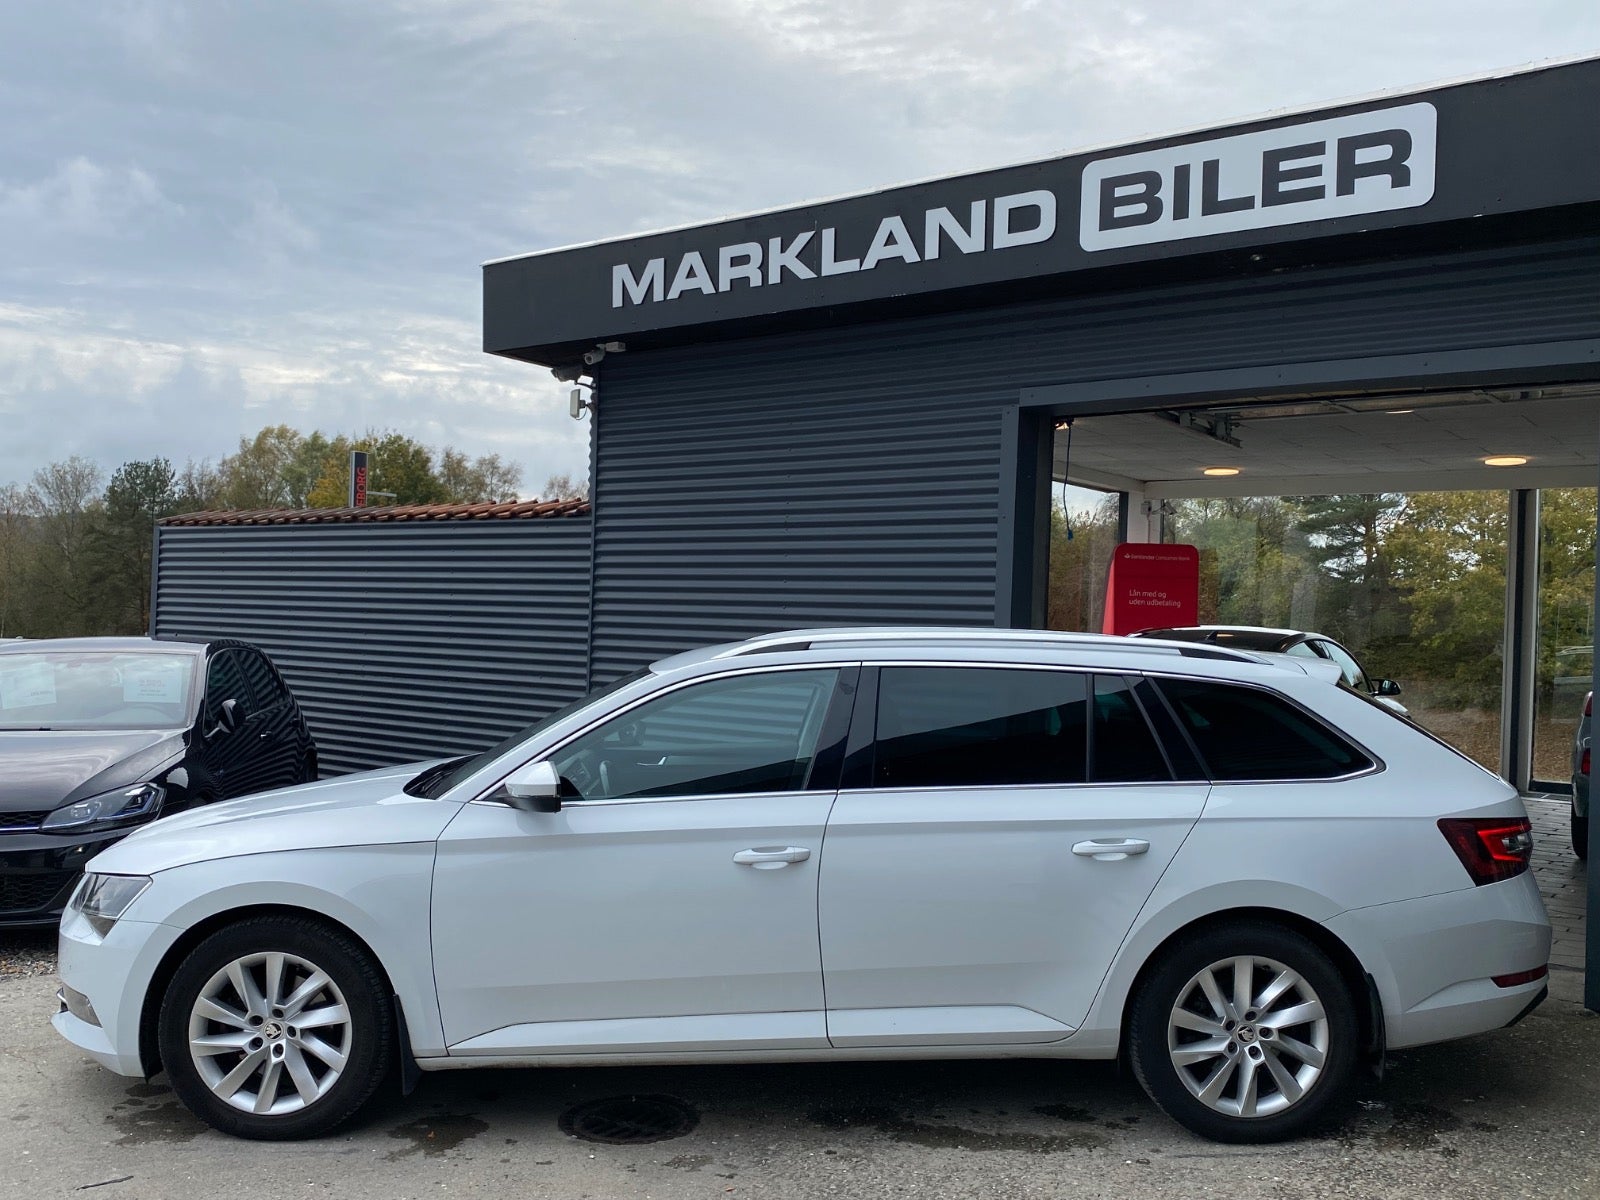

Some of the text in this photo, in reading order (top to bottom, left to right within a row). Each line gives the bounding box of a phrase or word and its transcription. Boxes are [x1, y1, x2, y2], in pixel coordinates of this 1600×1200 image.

[1098, 128, 1412, 231] BILER
[611, 189, 1056, 308] MARKLAND
[1142, 590, 1157, 598] med
[1147, 599, 1181, 608] udbetaling
